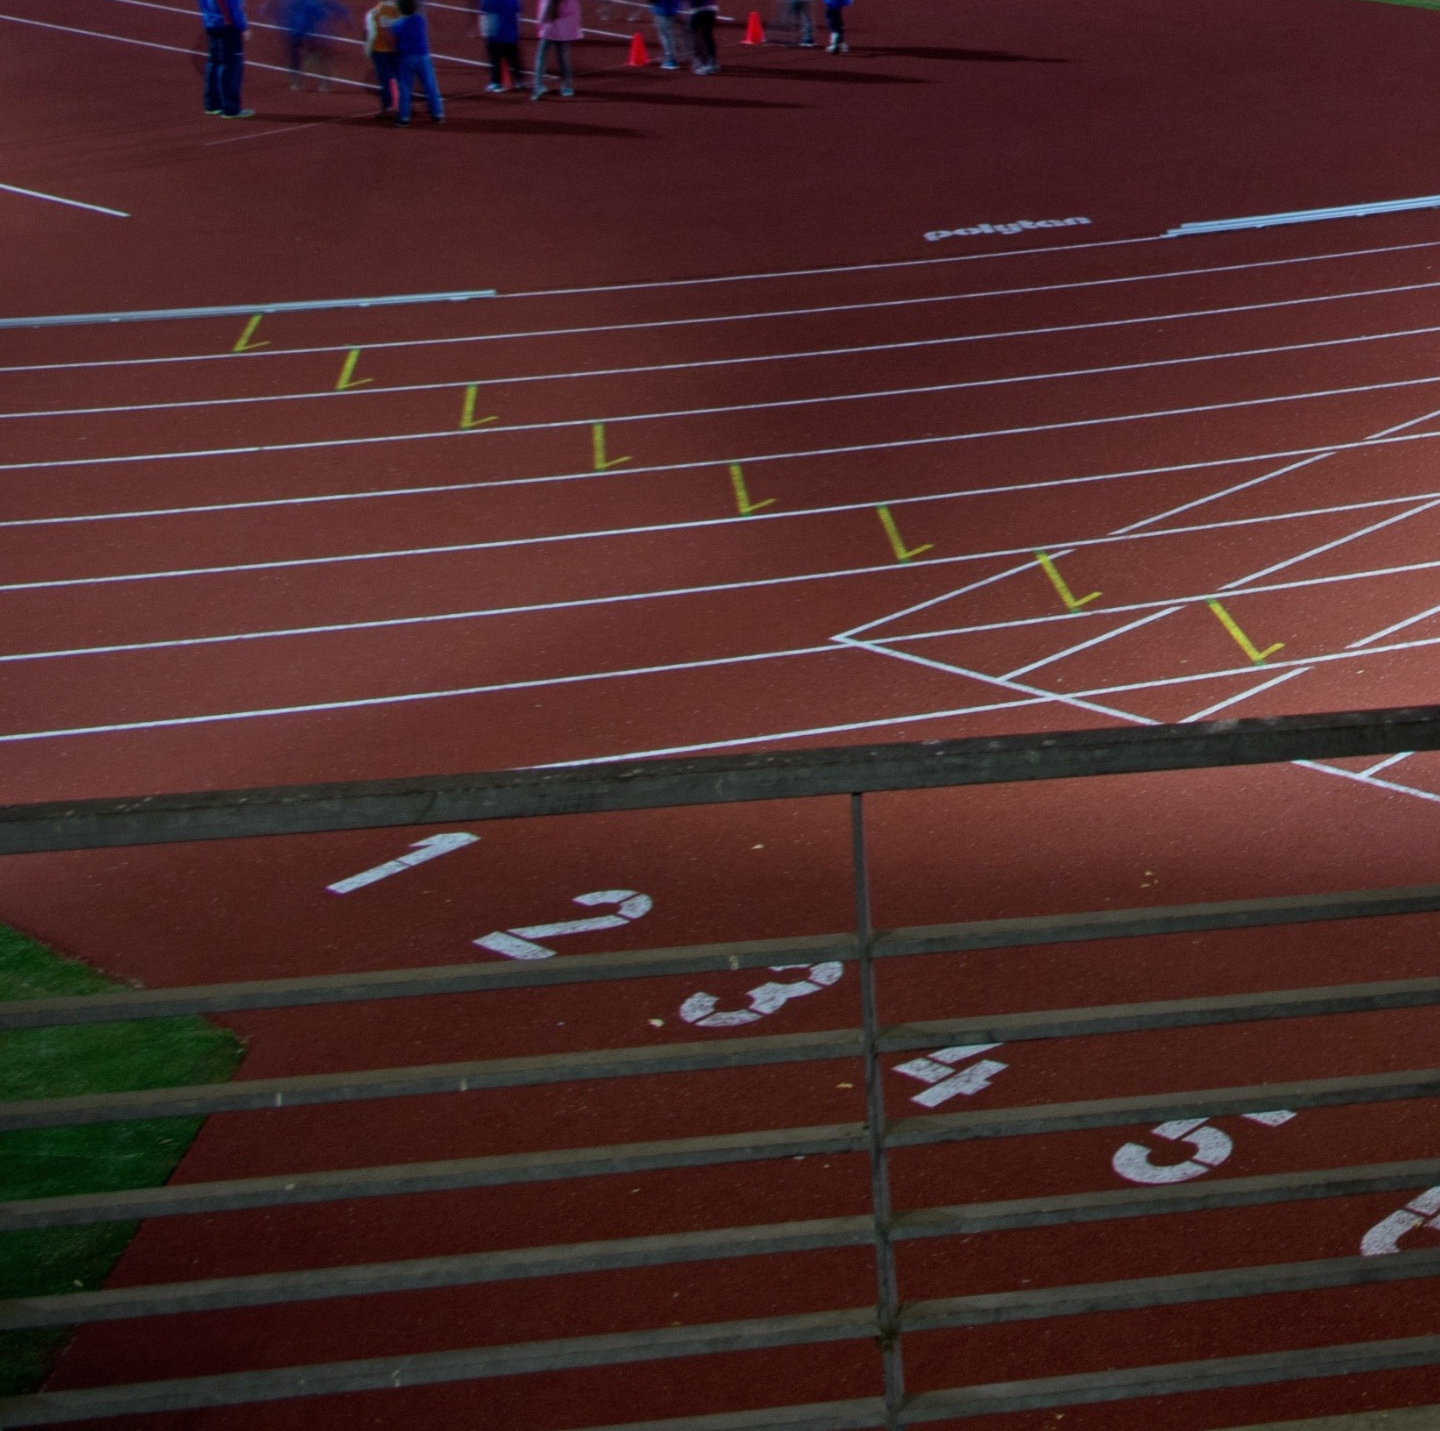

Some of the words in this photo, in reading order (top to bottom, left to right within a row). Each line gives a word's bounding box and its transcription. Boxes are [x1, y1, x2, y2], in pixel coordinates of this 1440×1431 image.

[923, 216, 1092, 242] polytan
[326, 832, 481, 894] 1
[472, 889, 653, 961] 2
[679, 960, 844, 1028] 3
[891, 1042, 1009, 1108] 4
[1112, 1109, 1297, 1184] 5
